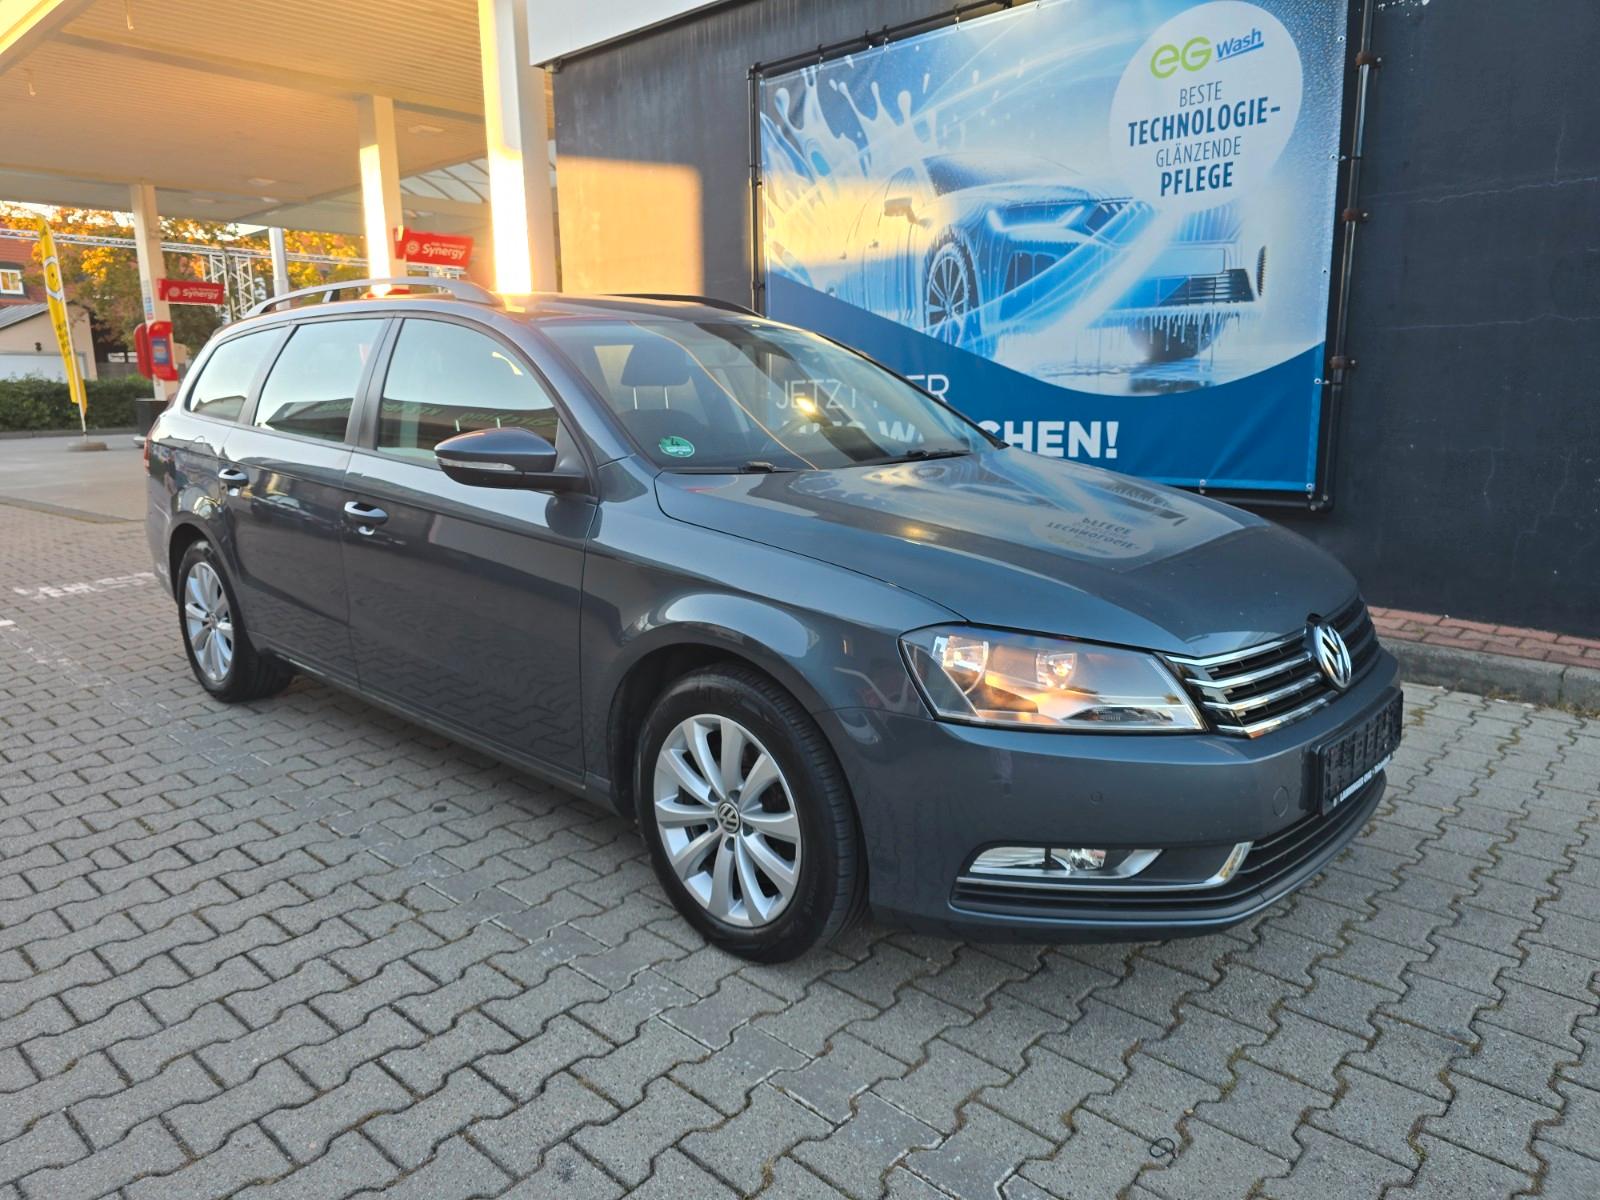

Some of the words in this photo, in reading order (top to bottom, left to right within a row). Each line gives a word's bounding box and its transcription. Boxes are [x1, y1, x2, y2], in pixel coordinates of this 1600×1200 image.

[1216, 28, 1263, 59] Wash
[1179, 80, 1223, 107] BESTE
[1128, 96, 1280, 147] TECHNOLOGIE-
[1156, 136, 1242, 167] GLÄNZENDE
[1160, 161, 1234, 197] PFLEGE
[421, 243, 466, 260] Synergy
[182, 287, 219, 300] Synergy
